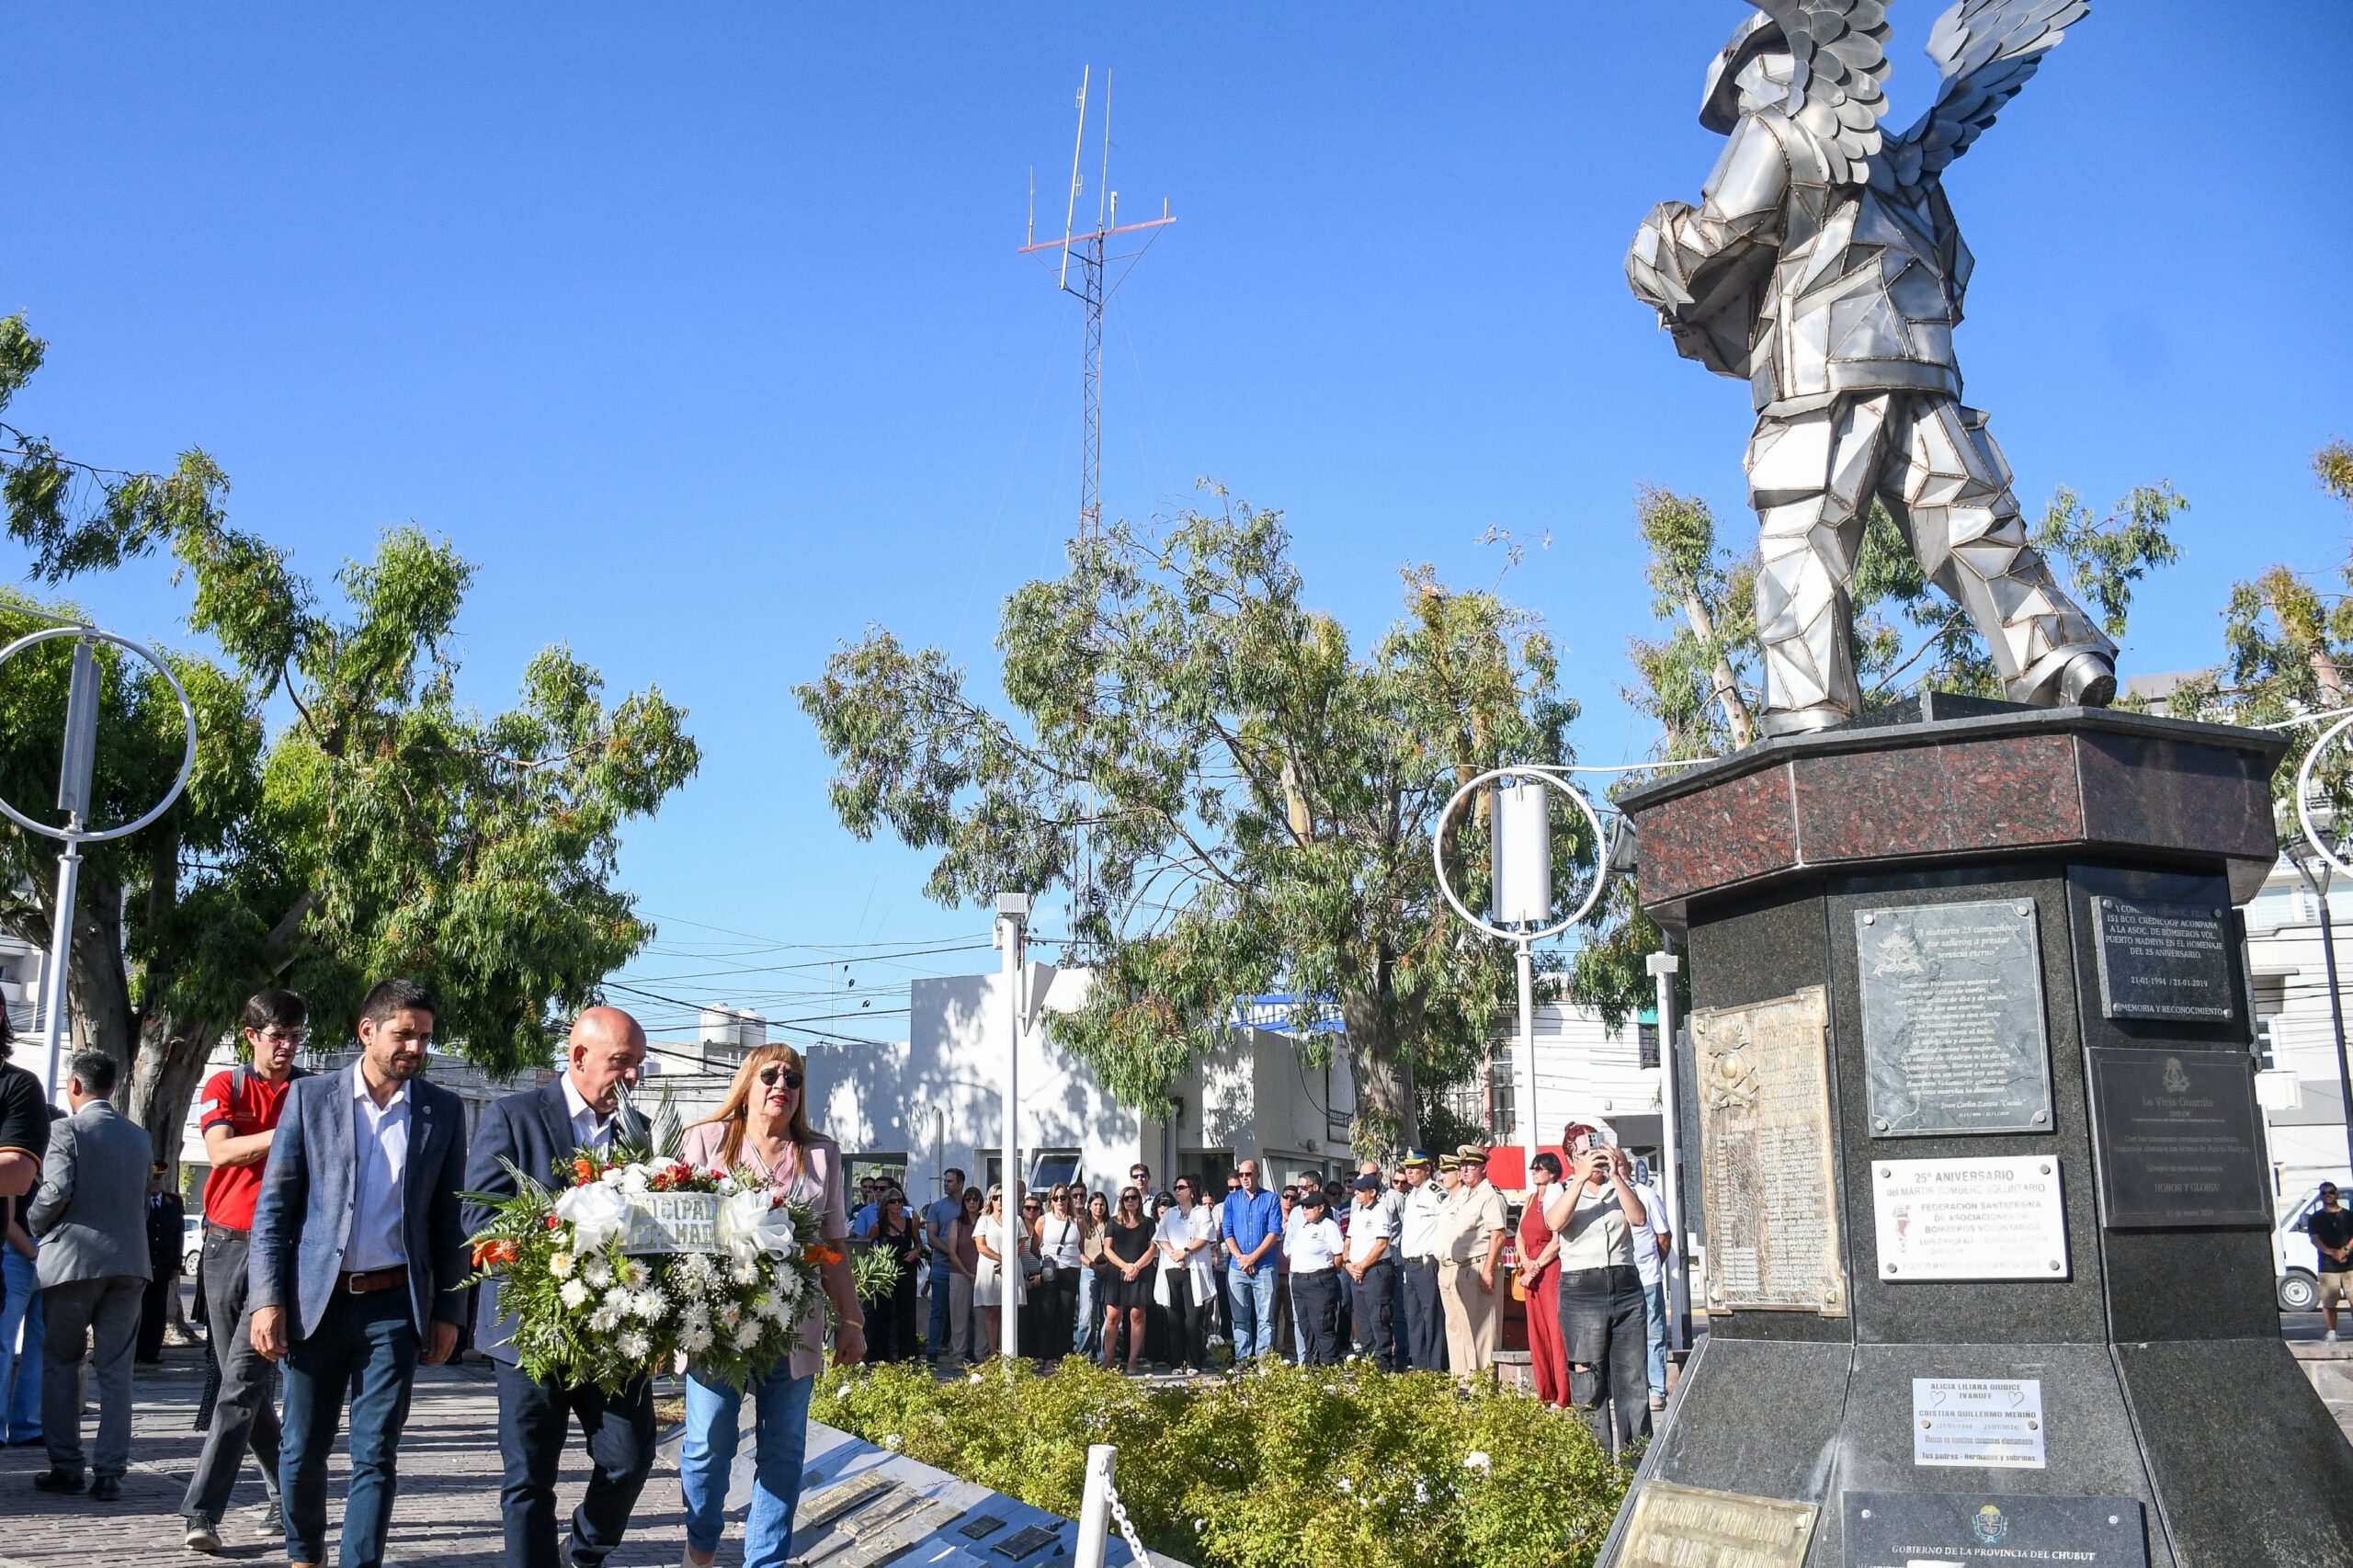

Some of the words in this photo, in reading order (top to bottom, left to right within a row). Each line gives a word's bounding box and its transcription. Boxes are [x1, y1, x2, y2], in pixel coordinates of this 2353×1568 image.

[2107, 915, 2119, 923] 151
[2138, 916, 2179, 926] CREDICOOP
[1926, 927, 1960, 937] nuestros
[1961, 926, 1972, 934] 25
[1973, 923, 2021, 935] compañeros
[2117, 926, 2126, 934] LA
[2161, 929, 2200, 938] BOMBEROS
[1924, 940, 1939, 949] que
[1981, 937, 2011, 947] prestar
[2106, 935, 2133, 945] PUERTO
[2135, 937, 2165, 947] MADRYN
[2177, 939, 2186, 948] EL
[2187, 940, 2224, 950] HOMENAJE
[2130, 947, 2144, 956] DEL
[2131, 976, 2166, 986] 21-01-1994
[2173, 978, 2208, 987] 21-01-2019
[2122, 1003, 2154, 1013] MEMORIA
[2155, 1005, 2161, 1013] Y
[2162, 1006, 2223, 1016] RECONOCIMIENTO
[1956, 1100, 1977, 1108] Carlos
[2143, 1096, 2154, 1107] La
[2155, 1096, 2177, 1108] Vieja
[2178, 1096, 2214, 1108] Guardia
[1936, 1169, 2014, 1183] ANIVERSARIO
[1886, 1187, 1899, 1197] del
[1938, 1185, 1982, 1196] BOMBERO
[1985, 1182, 2046, 1194] VOLUNTARIO
[2154, 1183, 2183, 1193] HONOR
[2183, 1183, 2189, 1192] Y
[1980, 1200, 2042, 1210] SANTAFESINA
[1948, 1212, 2014, 1221] ASOCIACIONES
[1925, 1224, 1976, 1233] BOMBEROS
[1977, 1222, 2041, 1233] VOLUNTARIOS
[1930, 1382, 1956, 1391] ALICIA
[1958, 1382, 1988, 1391] LILIANA
[1990, 1383, 2021, 1392] GIUDICE
[1918, 1410, 1956, 1418] CRISTIAN
[1957, 1410, 2003, 1418] GUILLERMO
[1951, 1436, 1973, 1445] nuestros
[2001, 1437, 2034, 1446] eternamente
[1922, 1451, 1934, 1460] Tus
[1935, 1452, 1959, 1461] padres
[1964, 1453, 1998, 1461] Hermanos
[1892, 1545, 1943, 1556] GOBIERNO
[1944, 1547, 1958, 1556] DE
[1959, 1547, 1973, 1557] LA
[1974, 1548, 2029, 1559] PROVINCIA
[2030, 1550, 2051, 1560] DEL
[2052, 1550, 2096, 1562] CHUBUT
